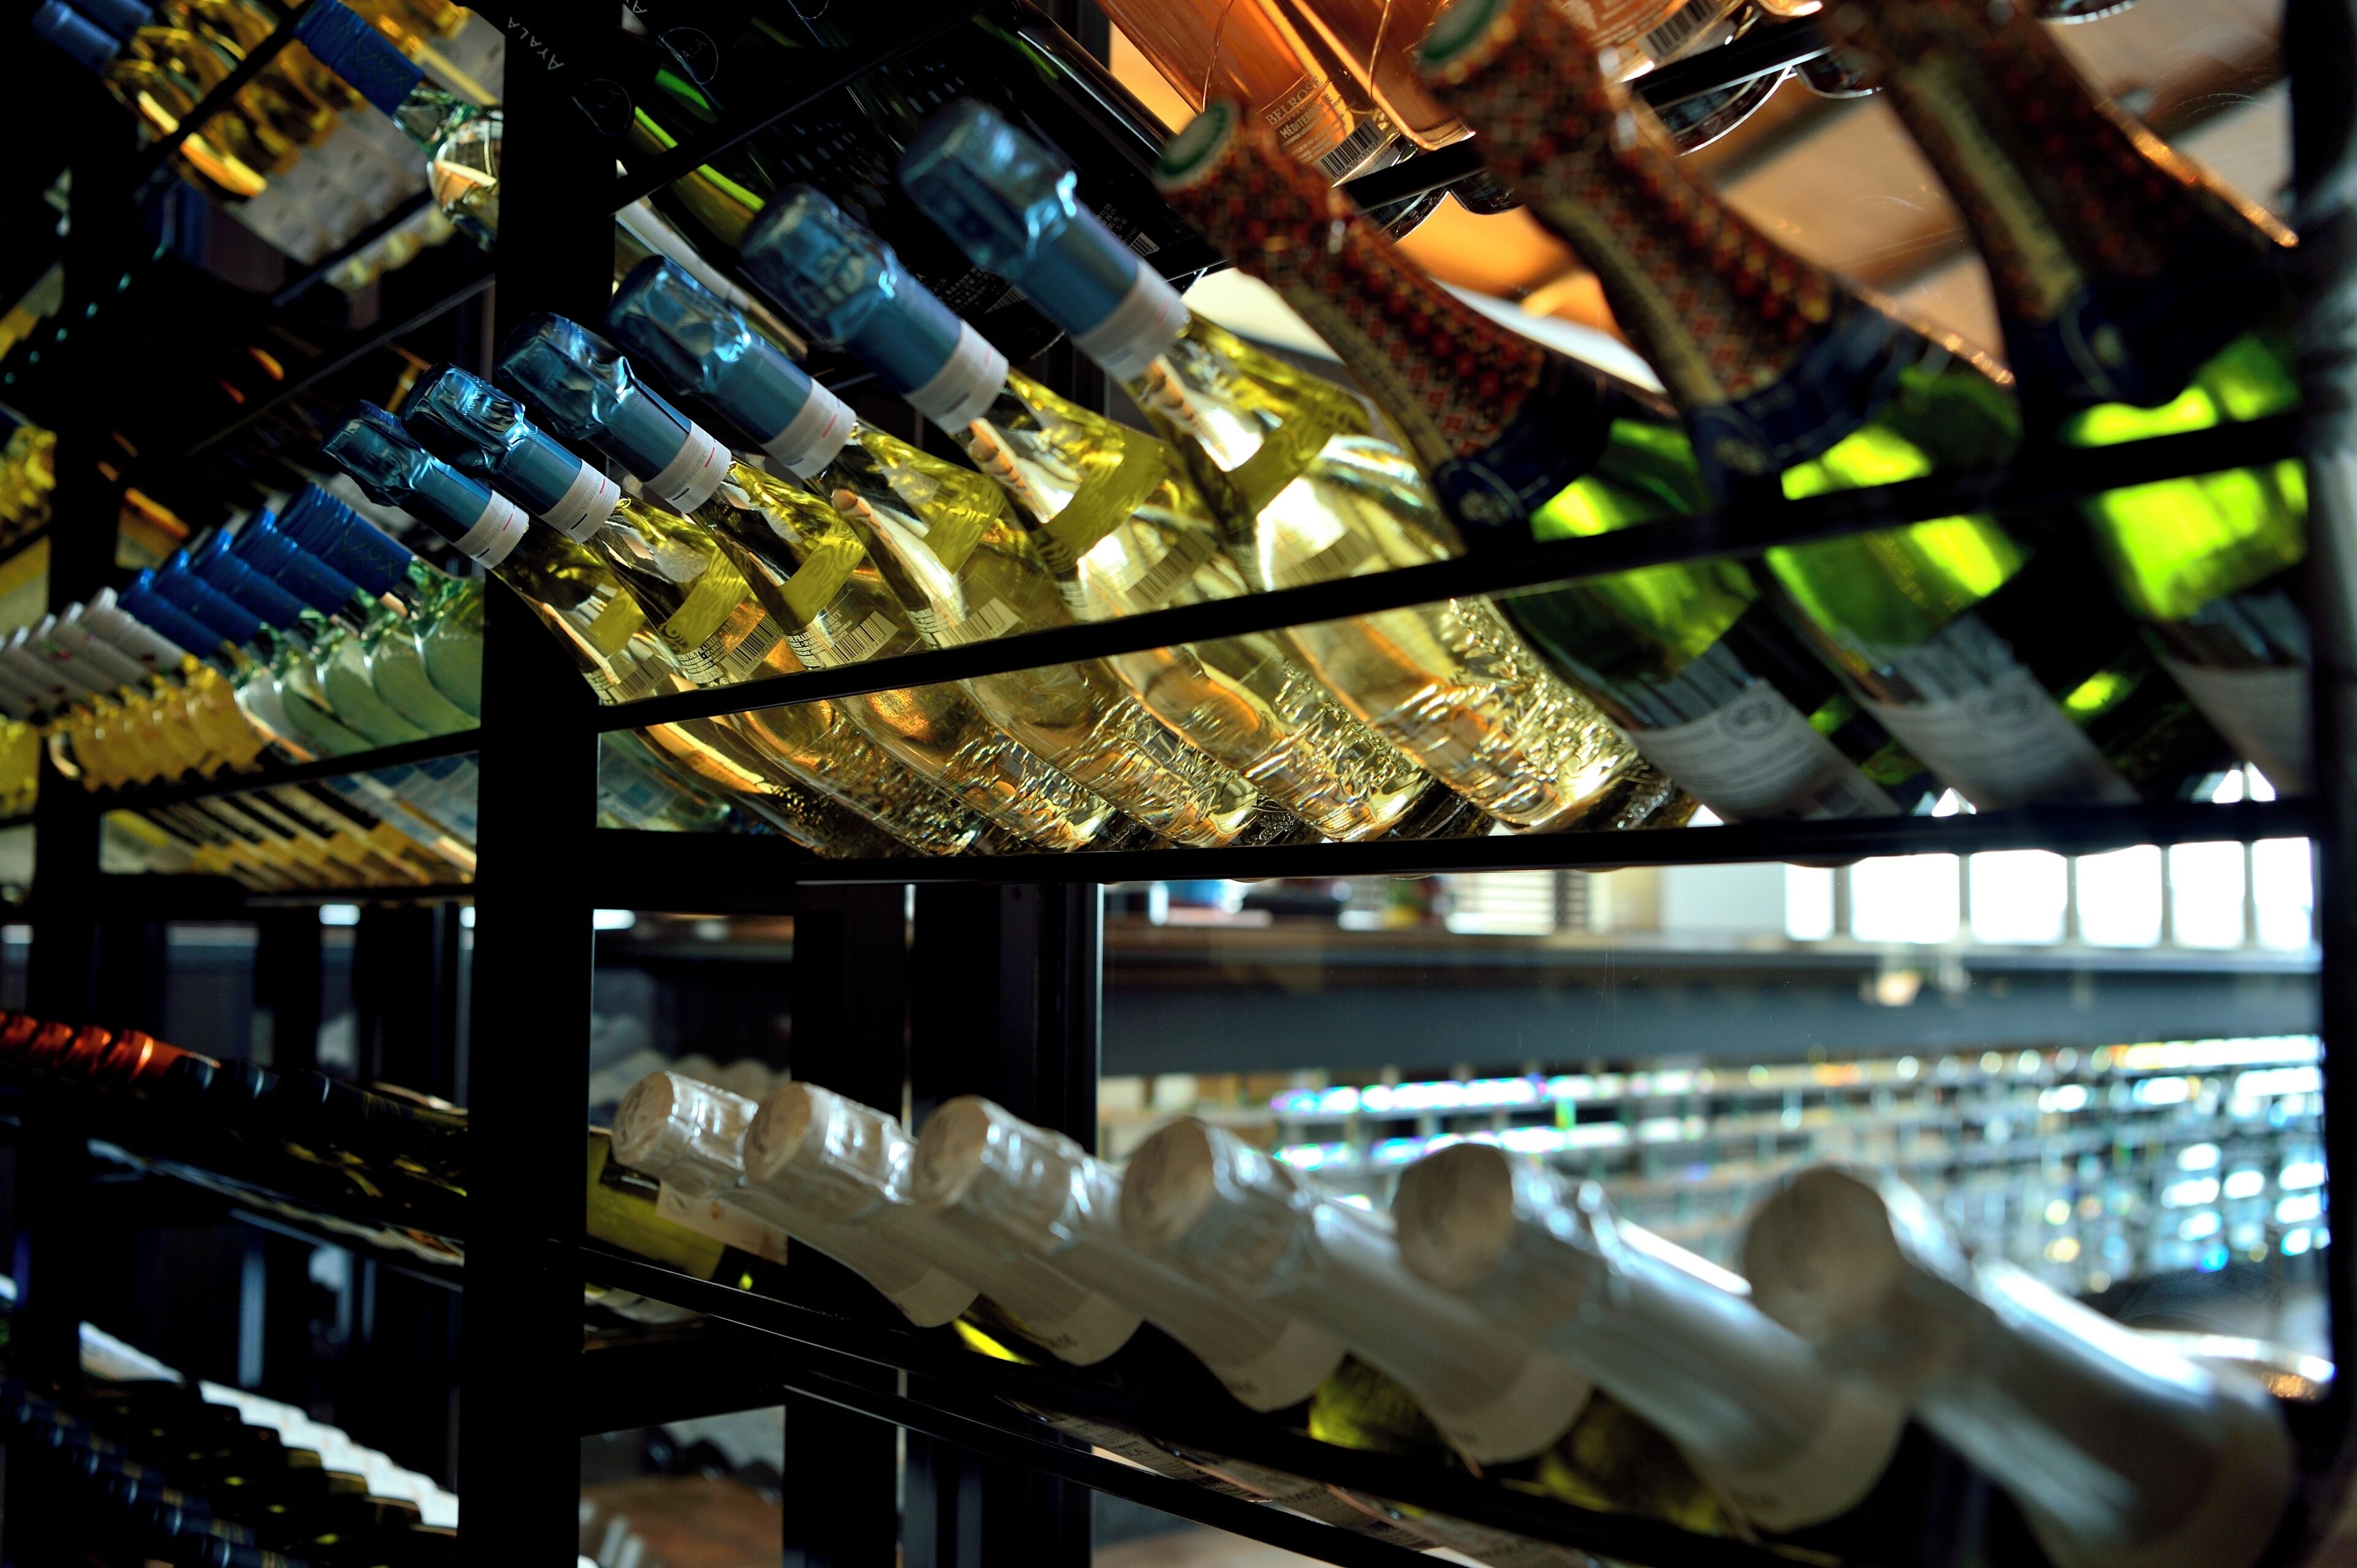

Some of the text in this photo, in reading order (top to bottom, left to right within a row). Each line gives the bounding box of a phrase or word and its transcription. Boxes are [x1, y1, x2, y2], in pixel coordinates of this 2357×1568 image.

[508, 17, 565, 70] AYALA
[681, 38, 706, 61] ALA
[1265, 75, 1321, 125] BELROSE
[1336, 157, 1358, 179] 500610
[1359, 140, 1380, 161] 135927
[694, 633, 720, 657] PRAIRIE
[722, 619, 736, 631] BRU
[746, 652, 764, 673] 500610
[764, 633, 782, 652] 13748
[864, 635, 887, 655] 137488
